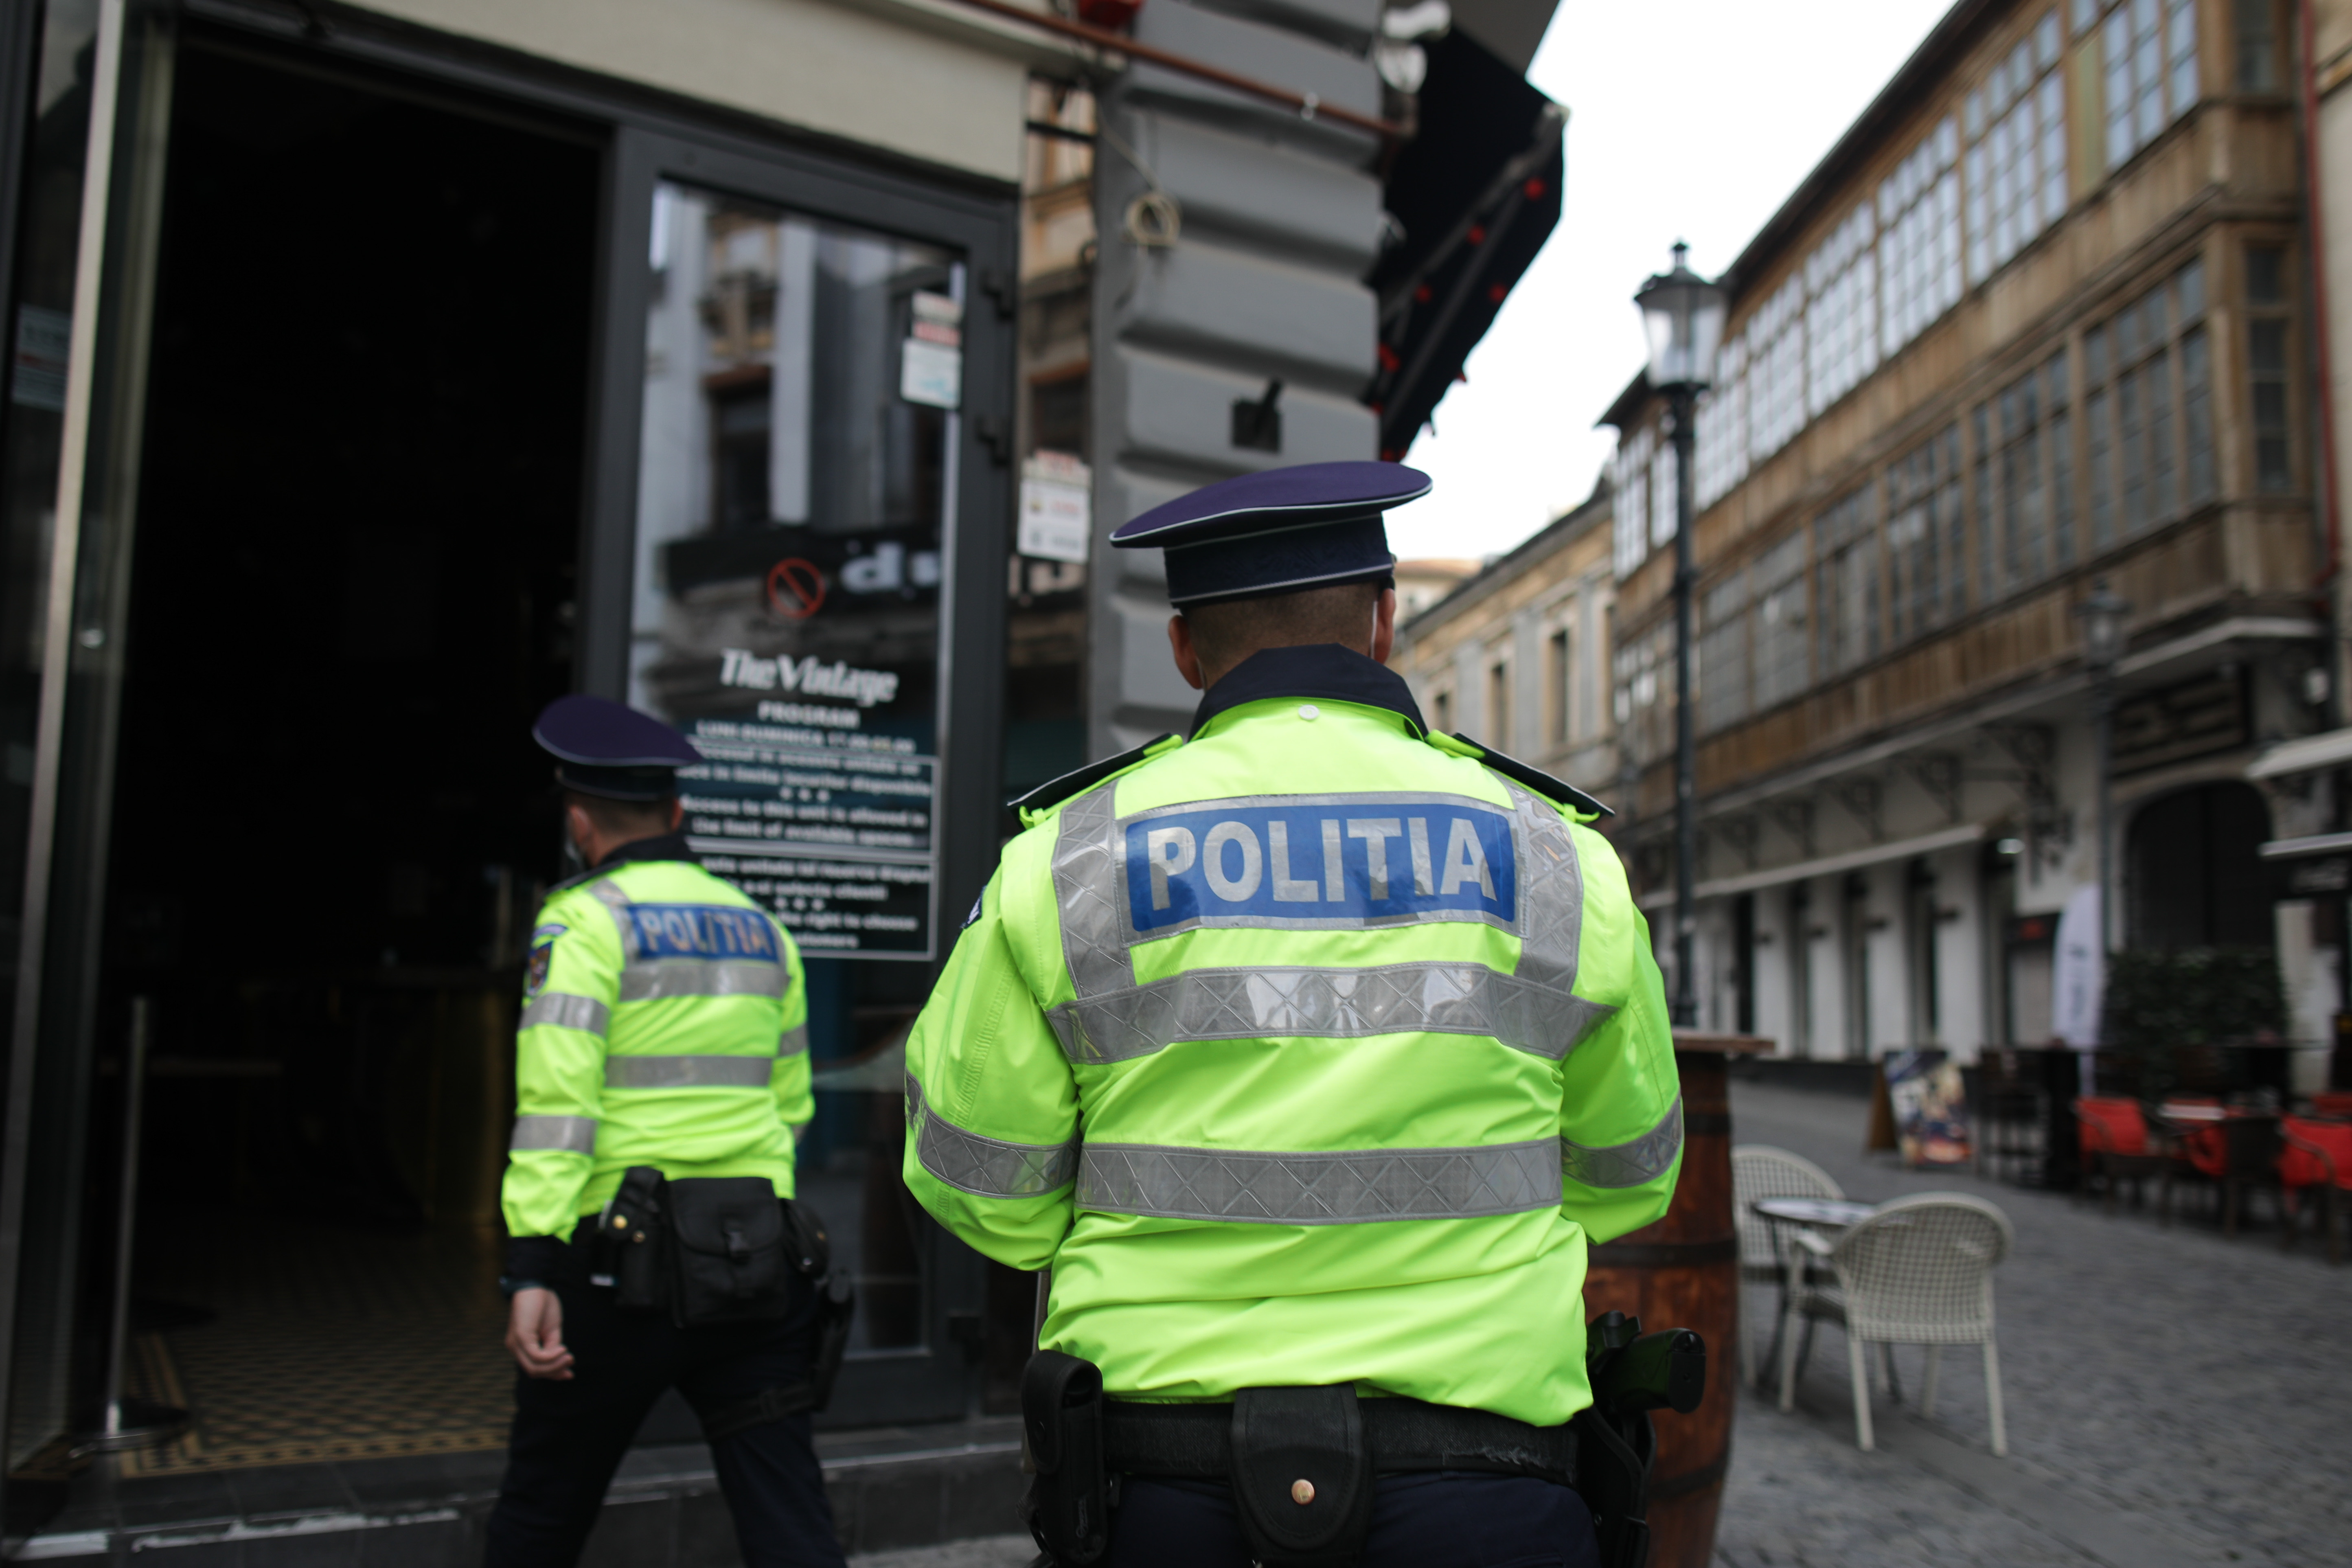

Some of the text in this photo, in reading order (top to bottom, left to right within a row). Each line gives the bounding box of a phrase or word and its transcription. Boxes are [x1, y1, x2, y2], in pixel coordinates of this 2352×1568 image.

[758, 700, 860, 730] PROGRAM
[1147, 817, 1497, 911] POLITIA
[636, 908, 772, 955] POLITIA
